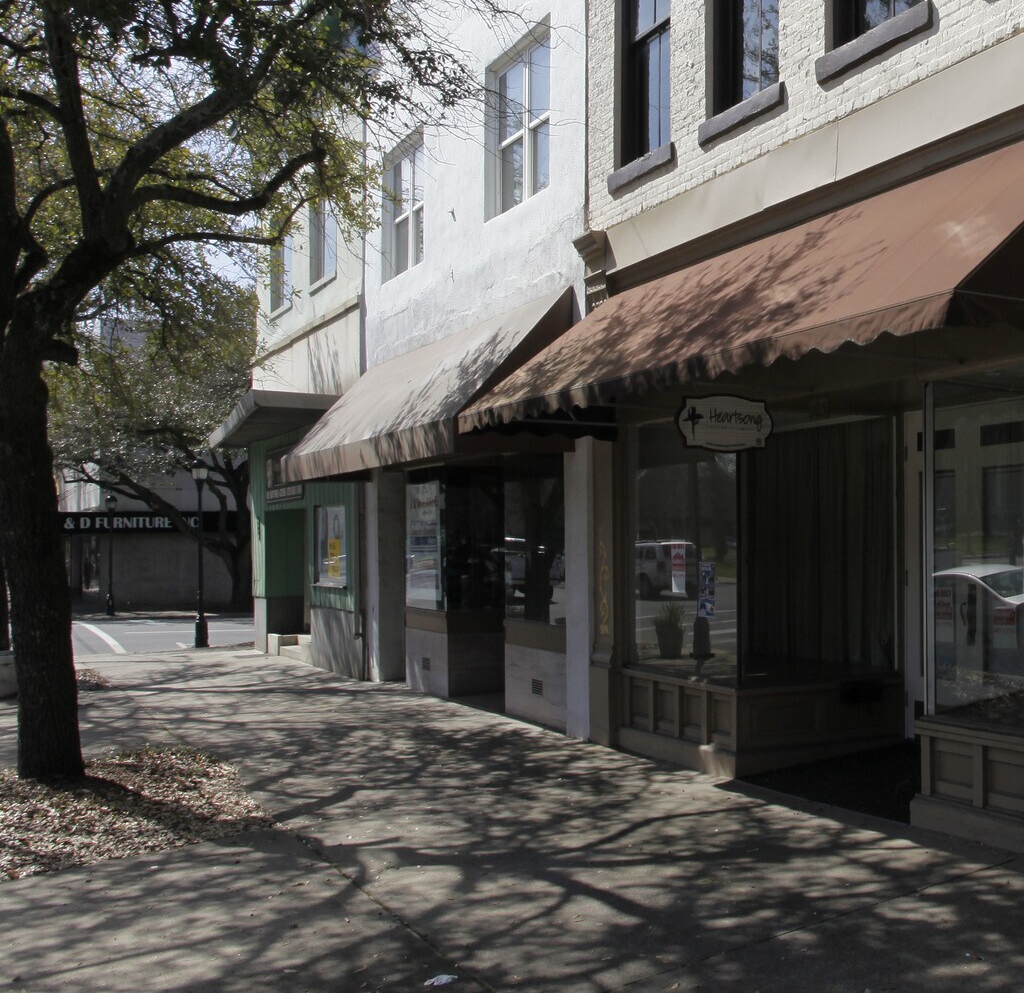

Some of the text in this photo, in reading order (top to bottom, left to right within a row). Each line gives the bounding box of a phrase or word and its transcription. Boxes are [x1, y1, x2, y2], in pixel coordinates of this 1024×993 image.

[709, 407, 762, 432] Heartsong
[63, 516, 75, 529] &
[79, 516, 90, 529] D
[95, 516, 173, 529] FURNITURE
